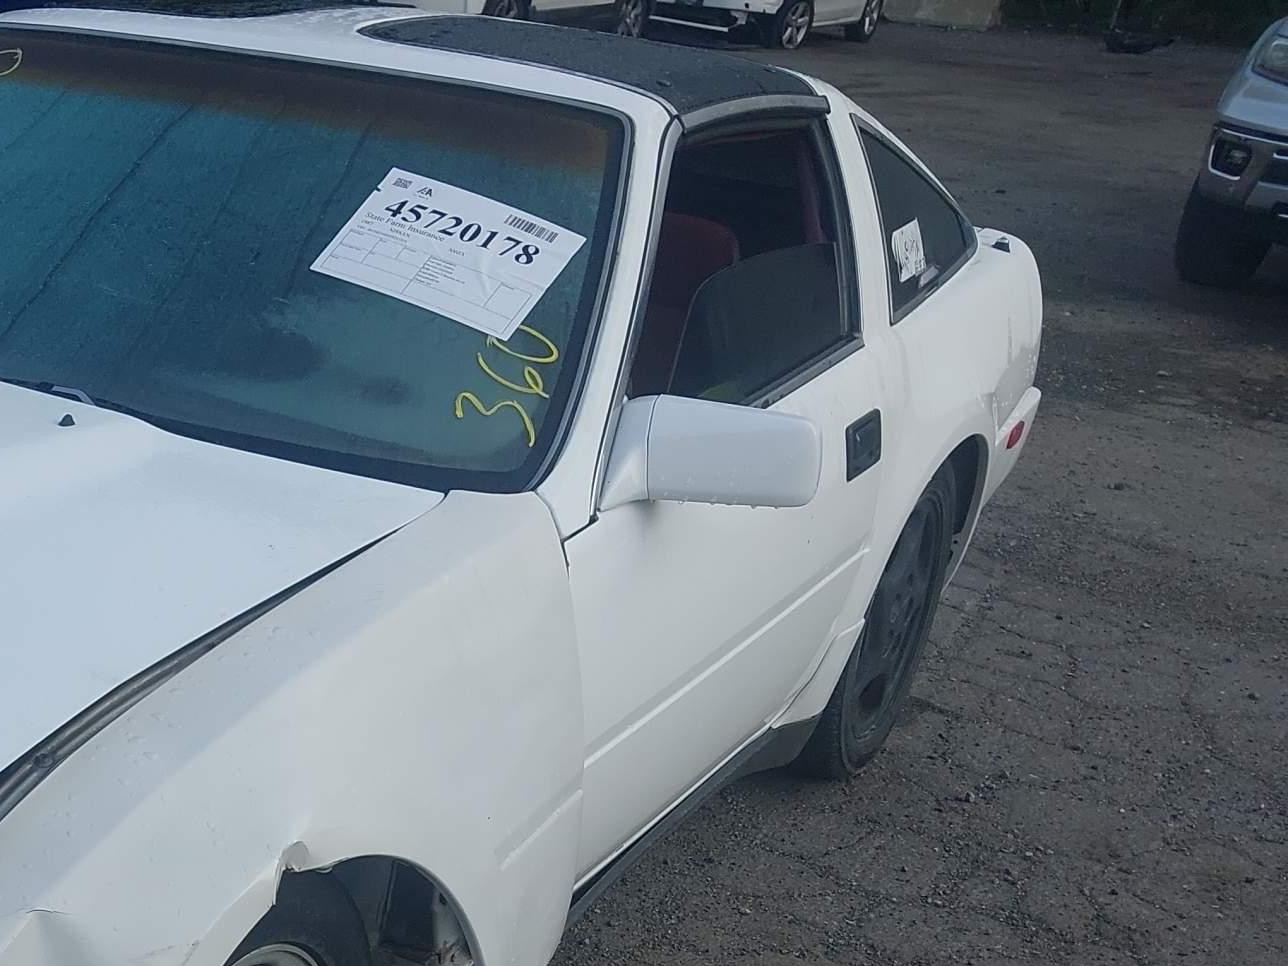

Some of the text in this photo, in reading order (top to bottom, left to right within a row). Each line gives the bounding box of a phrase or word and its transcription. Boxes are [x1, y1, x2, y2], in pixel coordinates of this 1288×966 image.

[365, 211, 386, 223] State
[384, 217, 406, 230] Farm
[407, 224, 446, 242] Insurance
[383, 199, 541, 266] 45720178
[454, 323, 560, 448] 360
